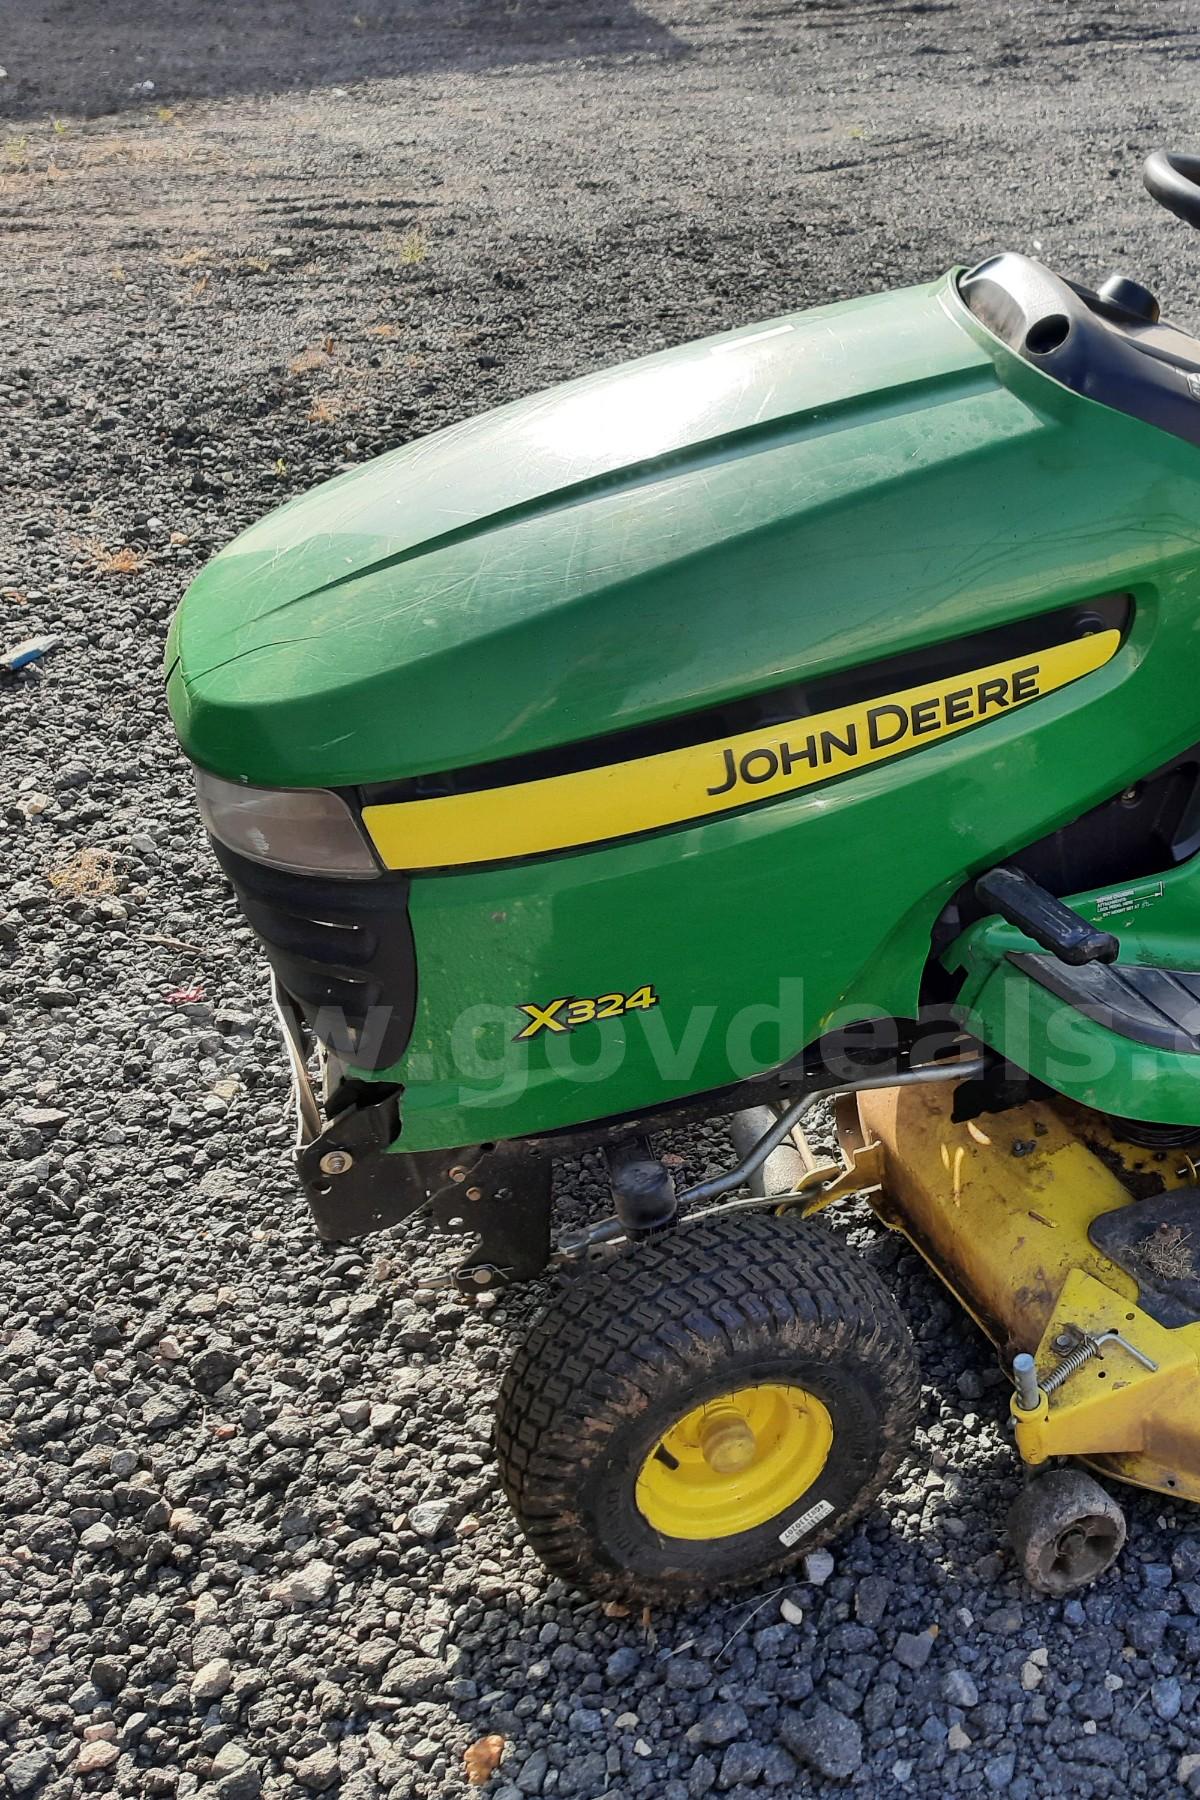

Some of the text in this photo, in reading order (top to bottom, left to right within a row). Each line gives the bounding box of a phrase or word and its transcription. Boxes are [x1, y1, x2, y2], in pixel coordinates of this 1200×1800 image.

[706, 665, 1040, 796] JOHN DEERE
[513, 985, 658, 1040] X324
